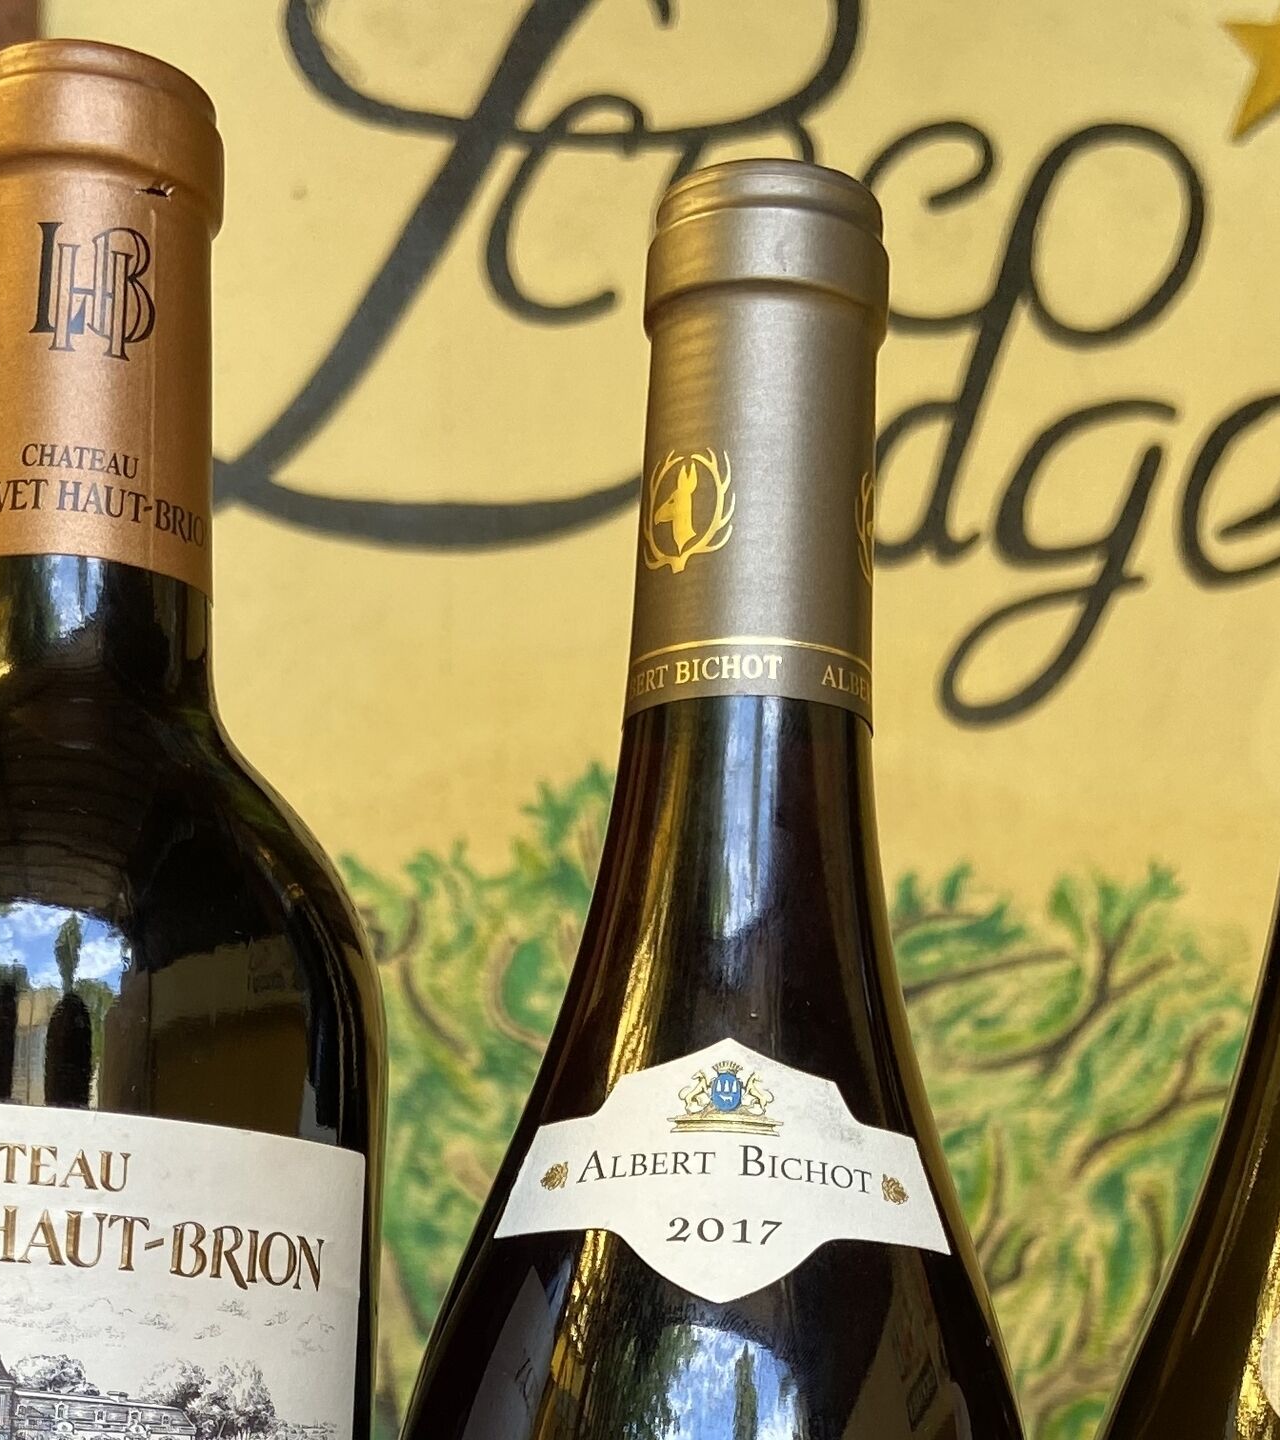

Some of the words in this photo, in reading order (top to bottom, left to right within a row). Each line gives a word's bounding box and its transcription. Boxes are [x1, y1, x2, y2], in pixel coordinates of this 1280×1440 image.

[21, 443, 139, 479] CHATEAU
[56, 479, 207, 547] HAUT-BRIO
[674, 654, 783, 684] BICHOT
[576, 1149, 716, 1184] ALBERT
[738, 1144, 872, 1195] BICHOT
[665, 1216, 783, 1246] 2017
